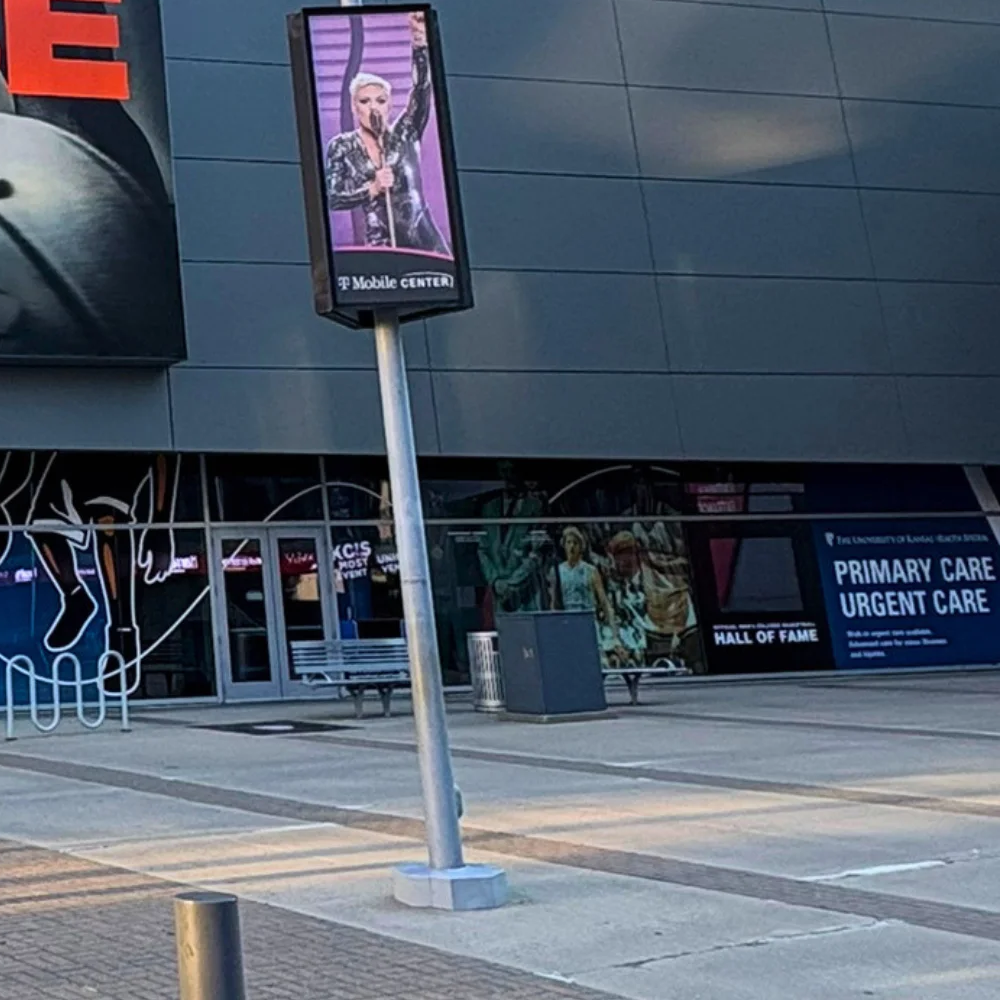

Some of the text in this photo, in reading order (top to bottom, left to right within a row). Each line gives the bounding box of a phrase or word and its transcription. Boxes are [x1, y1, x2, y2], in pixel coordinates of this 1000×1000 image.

[400, 276, 450, 289] CENTER
[338, 558, 368, 570] MOST
[833, 556, 996, 586] PRIMARY CARE
[839, 588, 990, 618] URGENT CARE
[714, 628, 819, 645] HALL OF FAME
